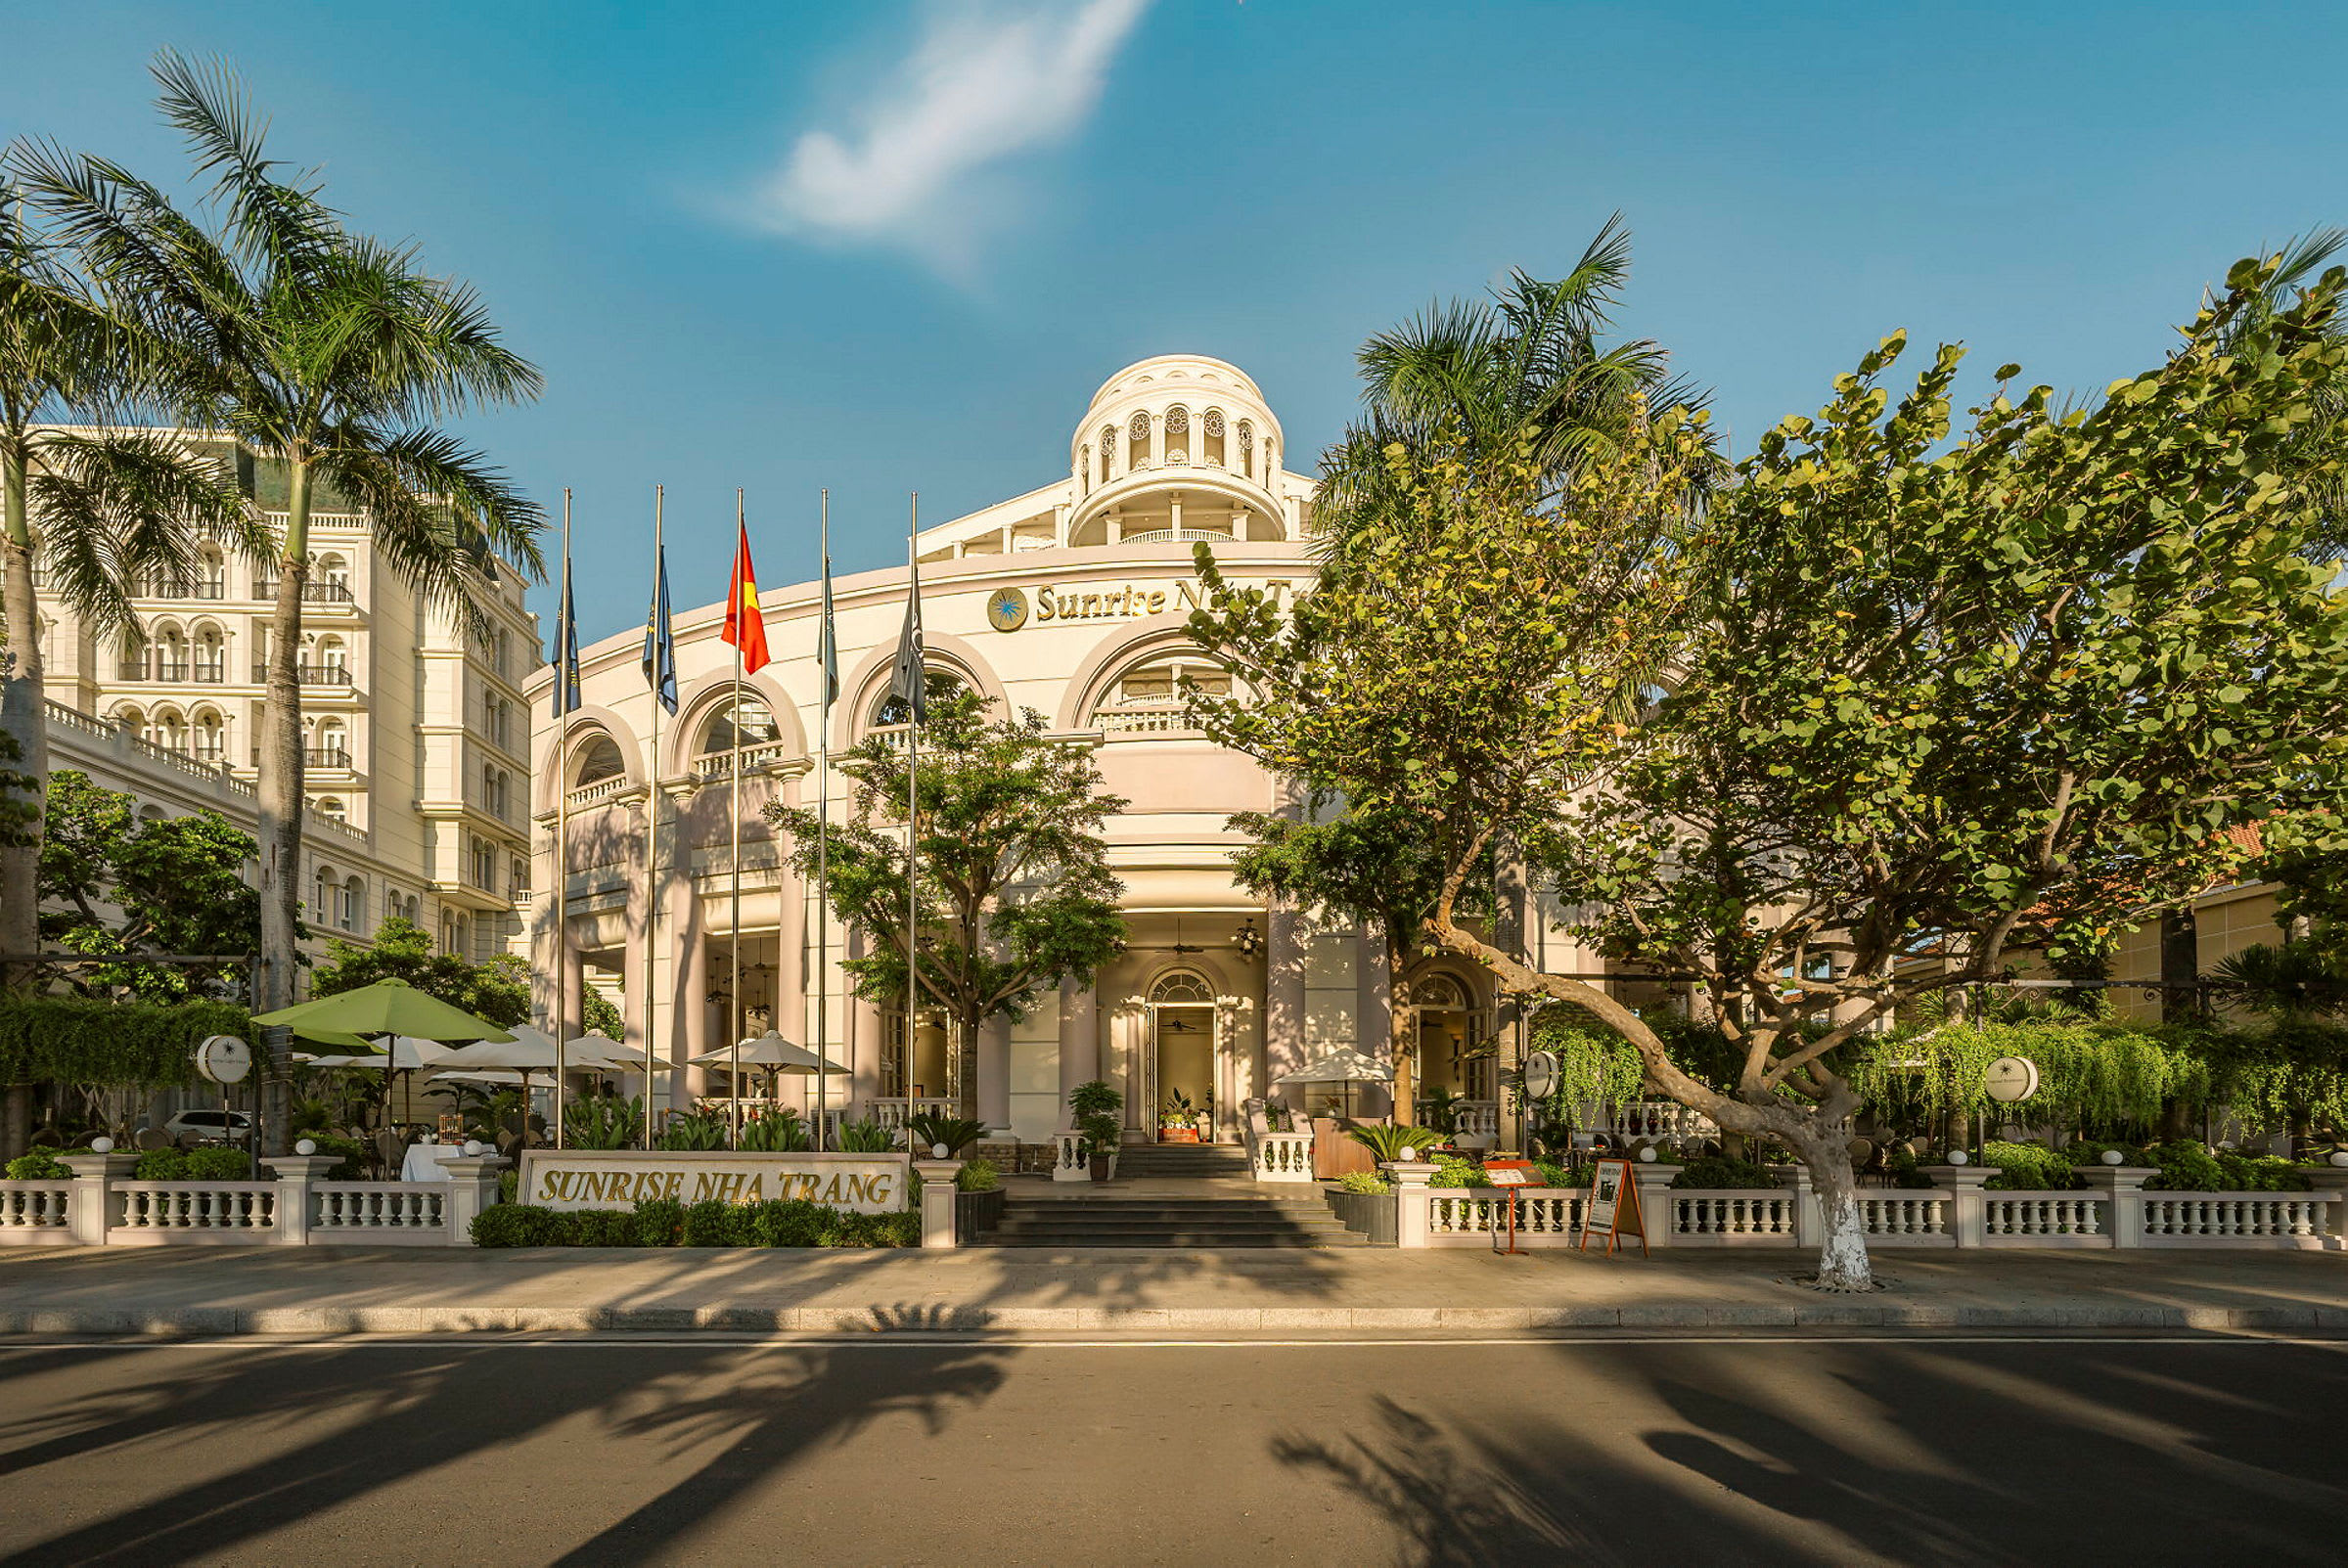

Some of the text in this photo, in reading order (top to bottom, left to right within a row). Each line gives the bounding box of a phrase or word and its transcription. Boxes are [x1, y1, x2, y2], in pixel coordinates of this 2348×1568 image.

[1036, 584, 1165, 622] Sunrise
[538, 1170, 892, 1204] SUNRISE NHA TRANG
